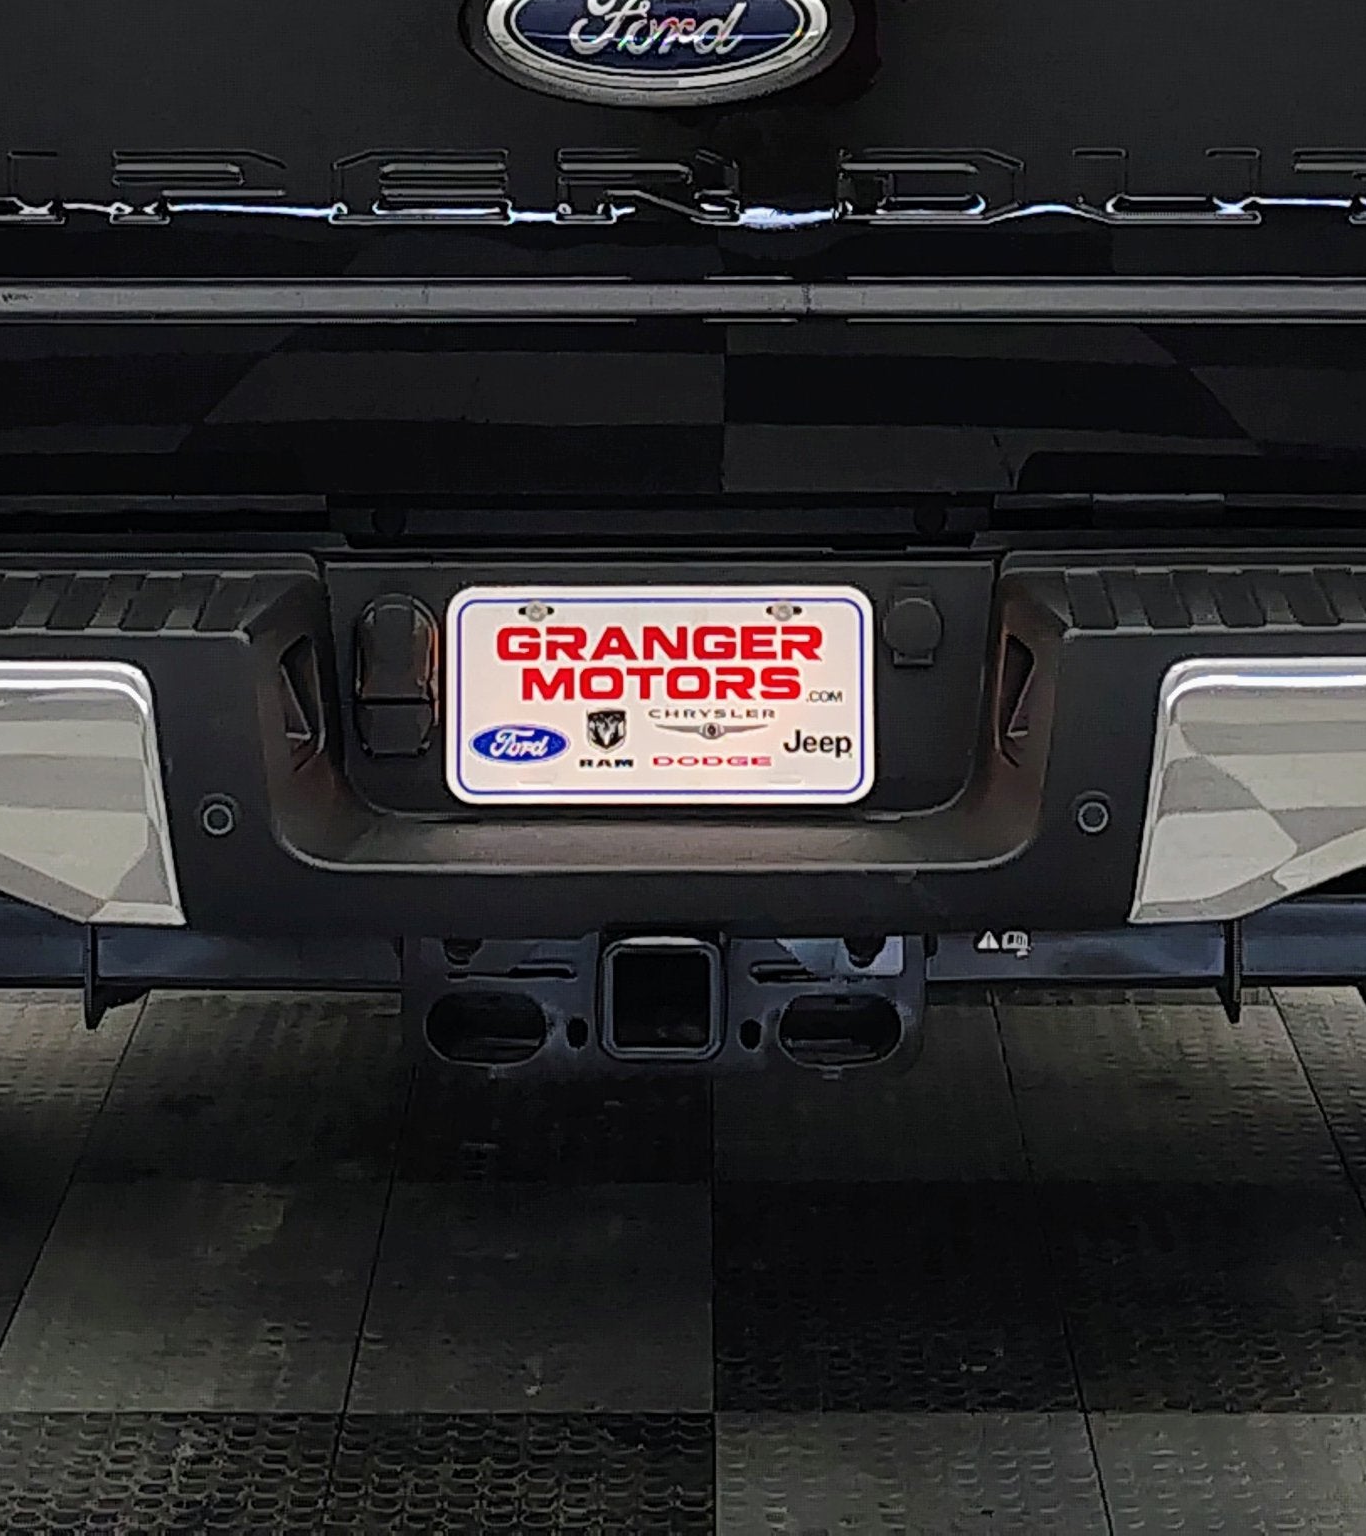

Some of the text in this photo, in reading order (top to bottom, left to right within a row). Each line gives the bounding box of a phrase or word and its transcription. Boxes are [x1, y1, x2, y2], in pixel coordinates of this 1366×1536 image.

[496, 626, 823, 660] GRANGER
[522, 667, 802, 700] MOTORS
[648, 708, 775, 718] CHRYSLER
[487, 729, 550, 761] Ford
[784, 729, 852, 758] Jeep
[579, 758, 634, 768] RAM
[653, 757, 772, 767] DODGE
